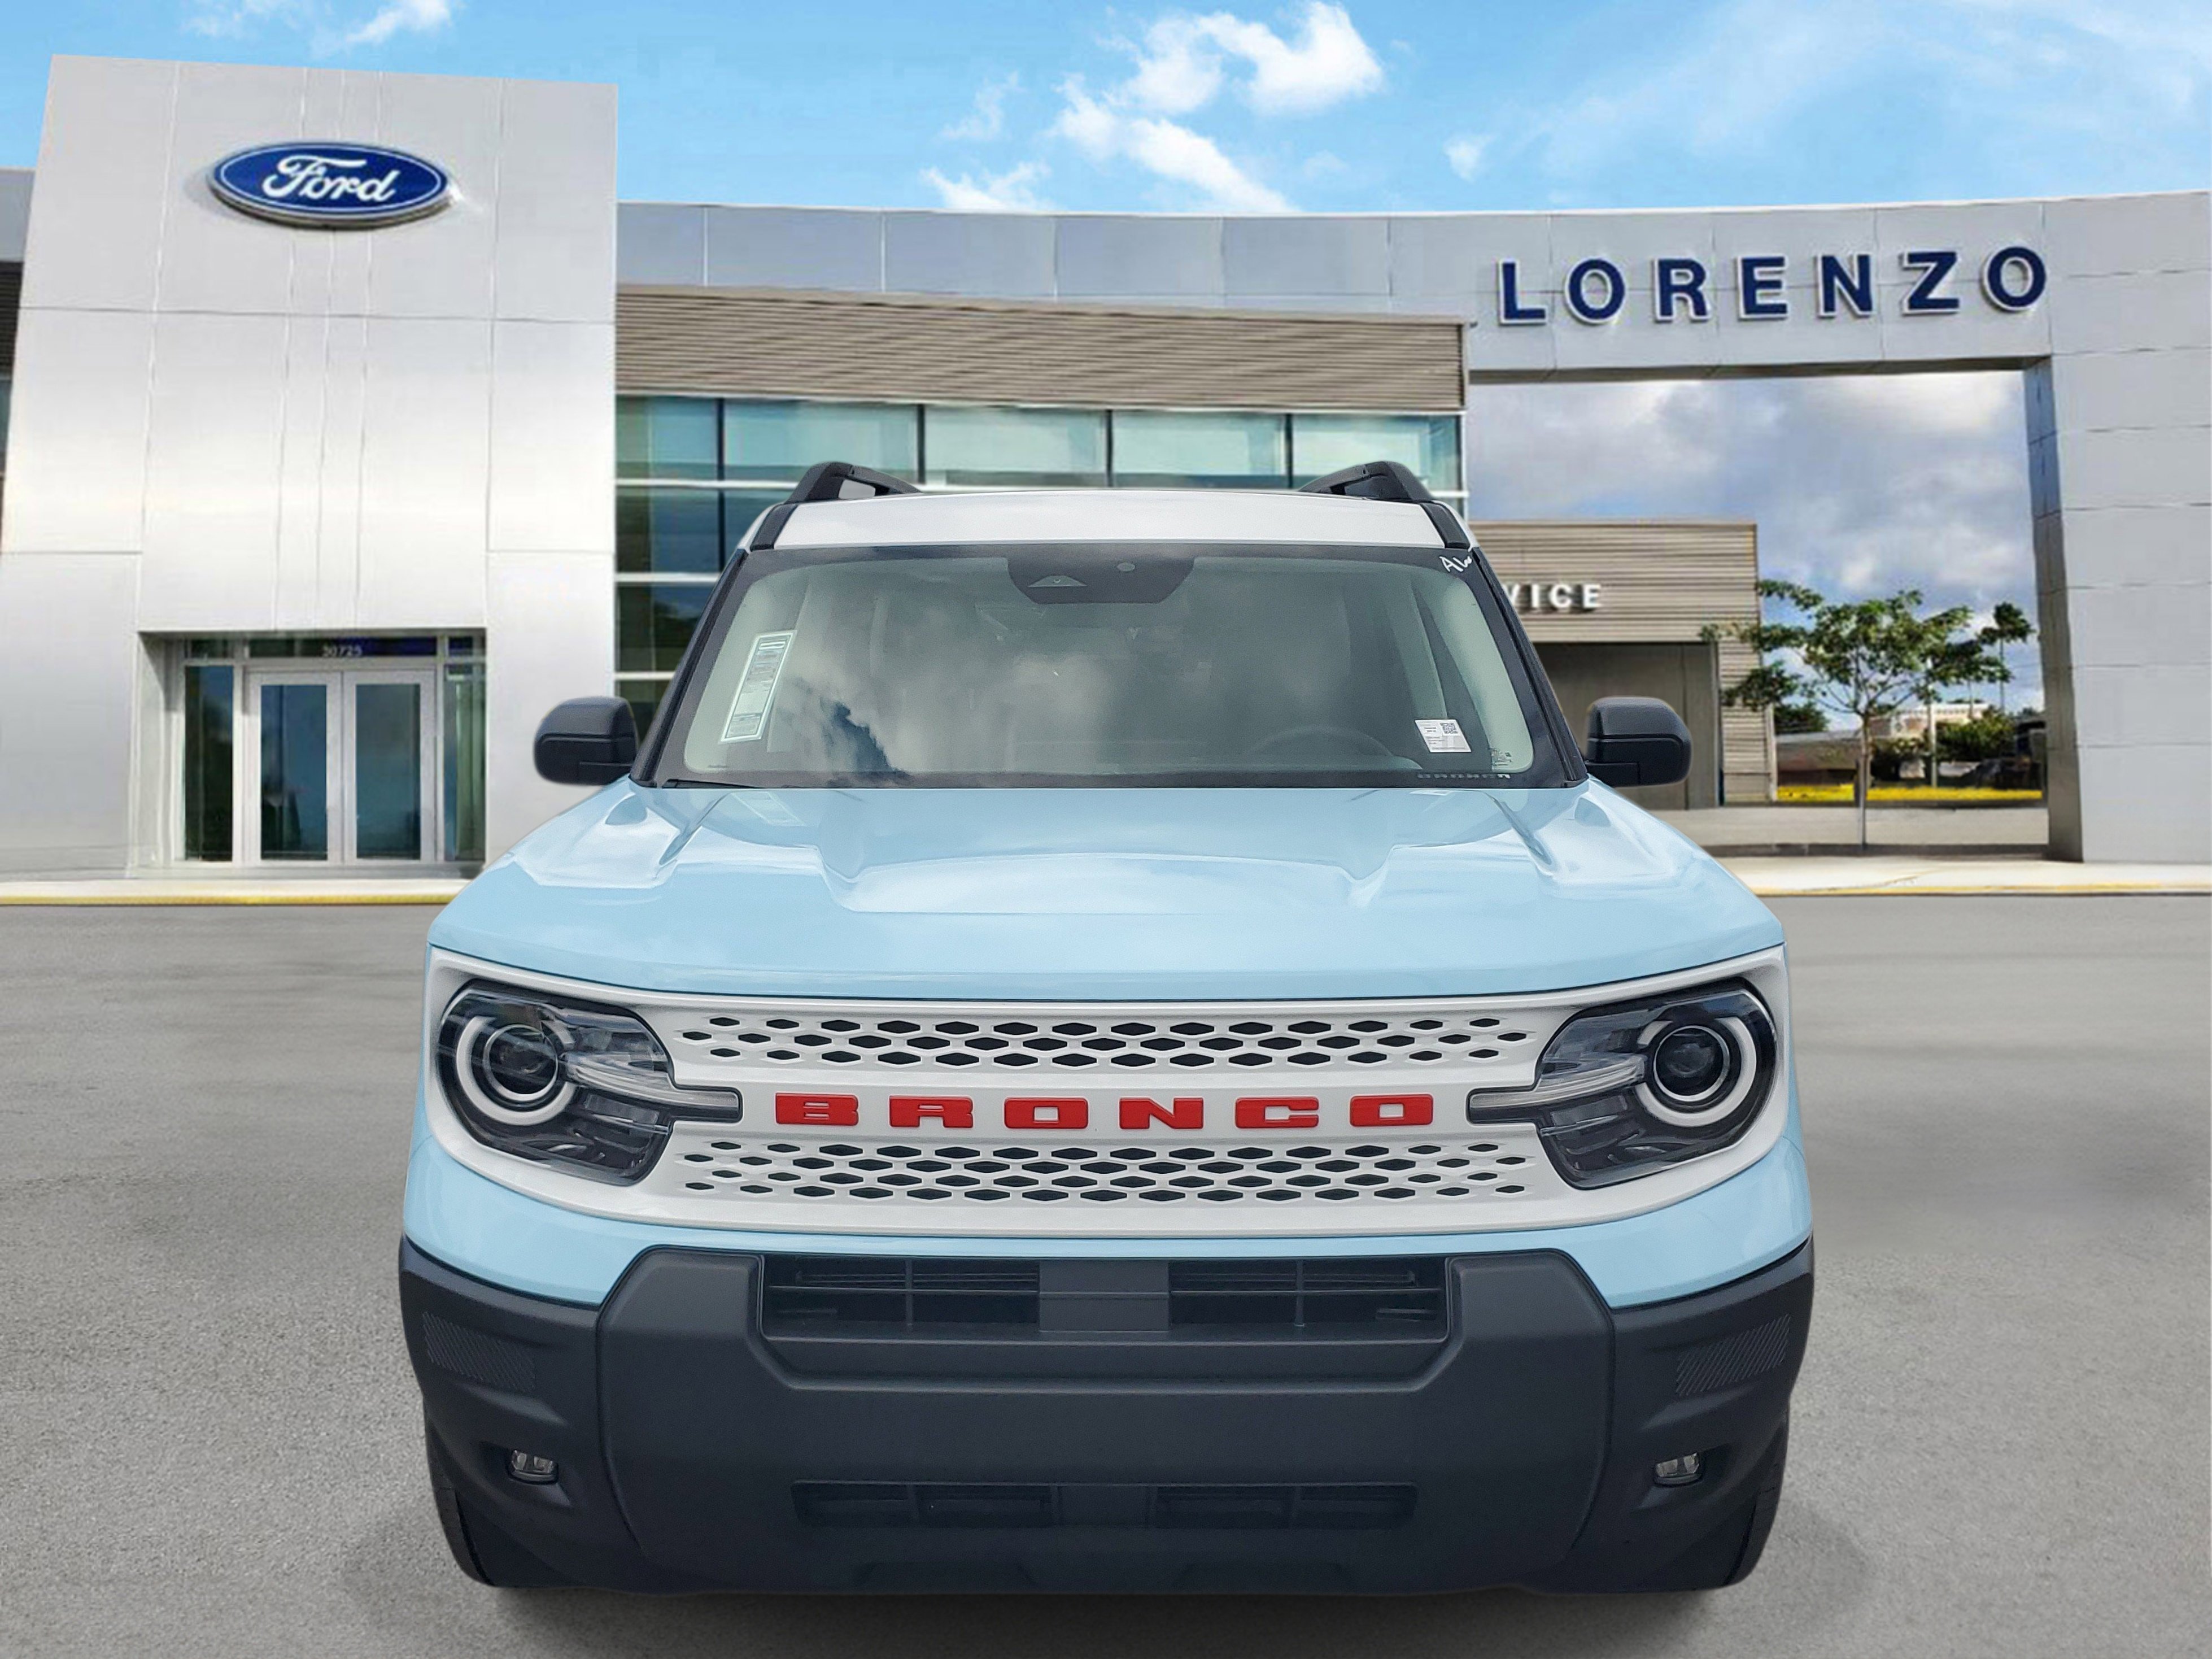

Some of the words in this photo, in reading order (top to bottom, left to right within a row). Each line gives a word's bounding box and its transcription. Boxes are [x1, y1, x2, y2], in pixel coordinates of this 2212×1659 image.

[262, 154, 400, 202] Ford
[1498, 246, 2047, 324] LORENZO
[775, 1092, 1434, 1130] BRONCO
